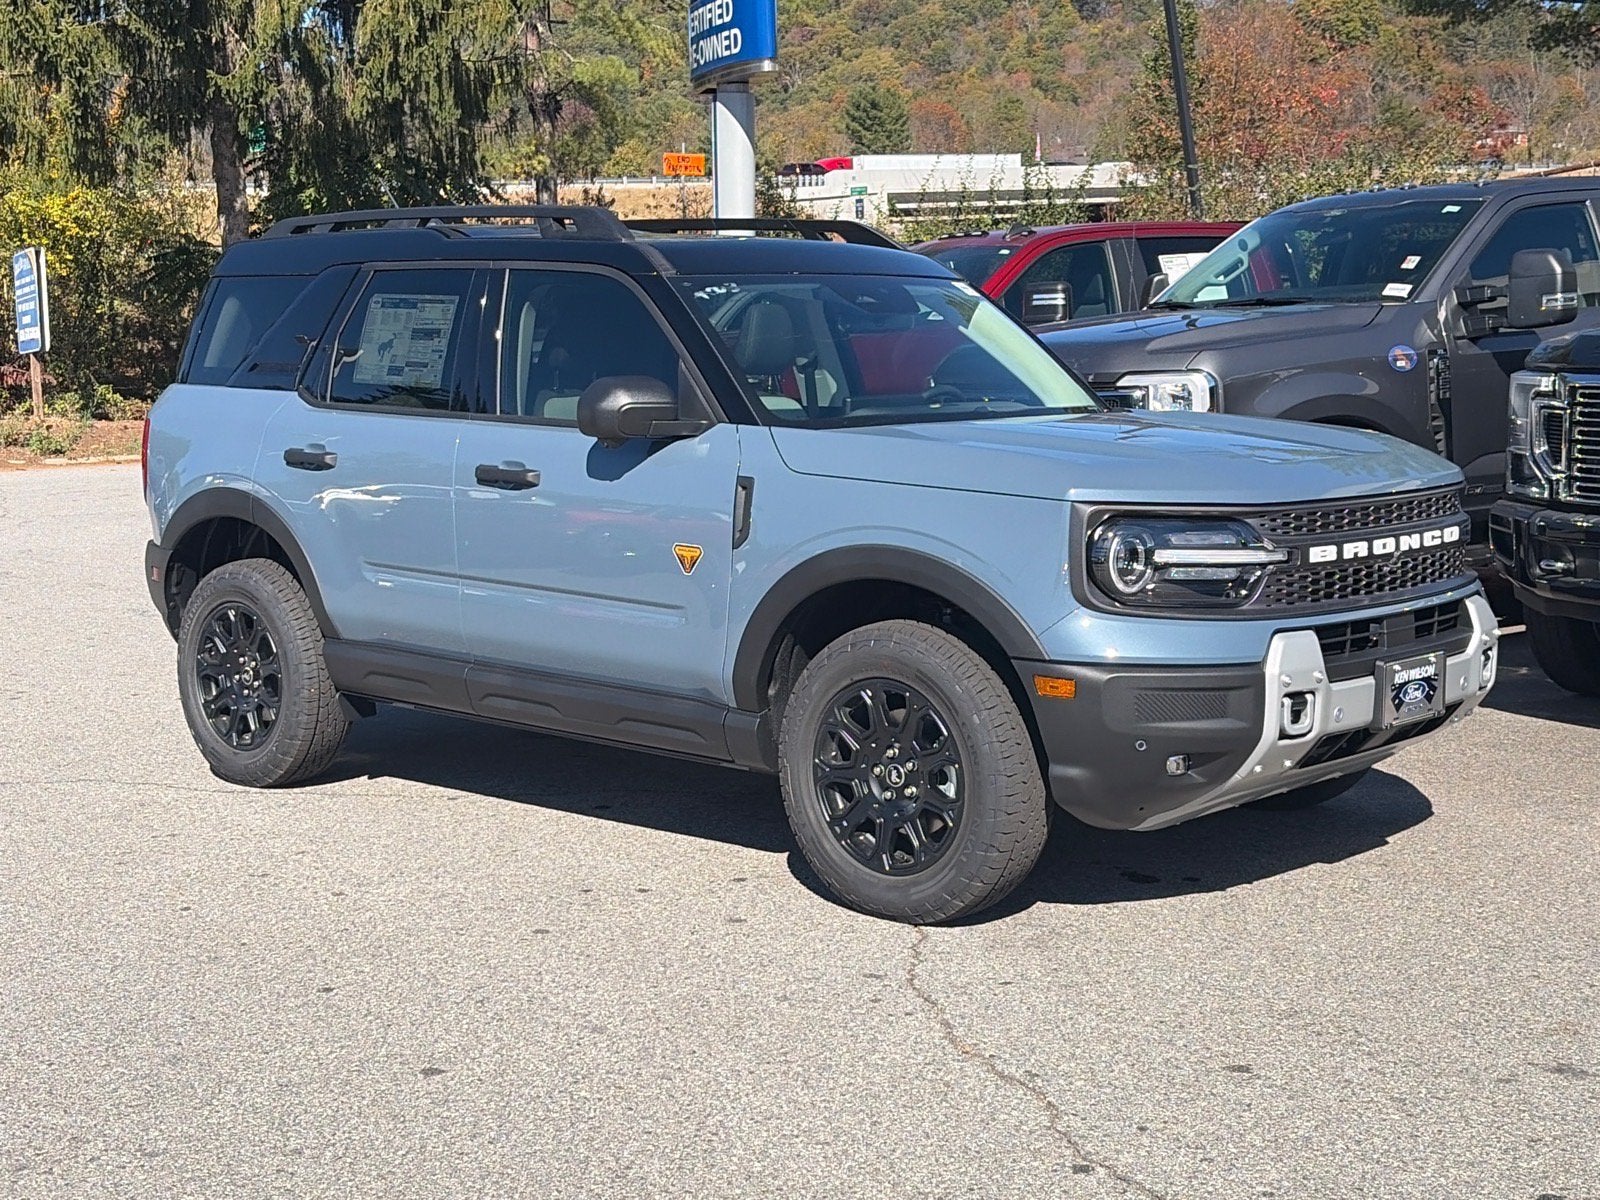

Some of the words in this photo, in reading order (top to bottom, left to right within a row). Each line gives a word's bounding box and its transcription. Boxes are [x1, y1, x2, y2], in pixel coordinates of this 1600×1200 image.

[689, 0, 734, 37] ERTIFIED
[689, 27, 742, 69] E-OWNED
[1309, 526, 1460, 563] BRONCO
[1394, 669, 1409, 684] KEN
[1405, 684, 1423, 700] Ford
